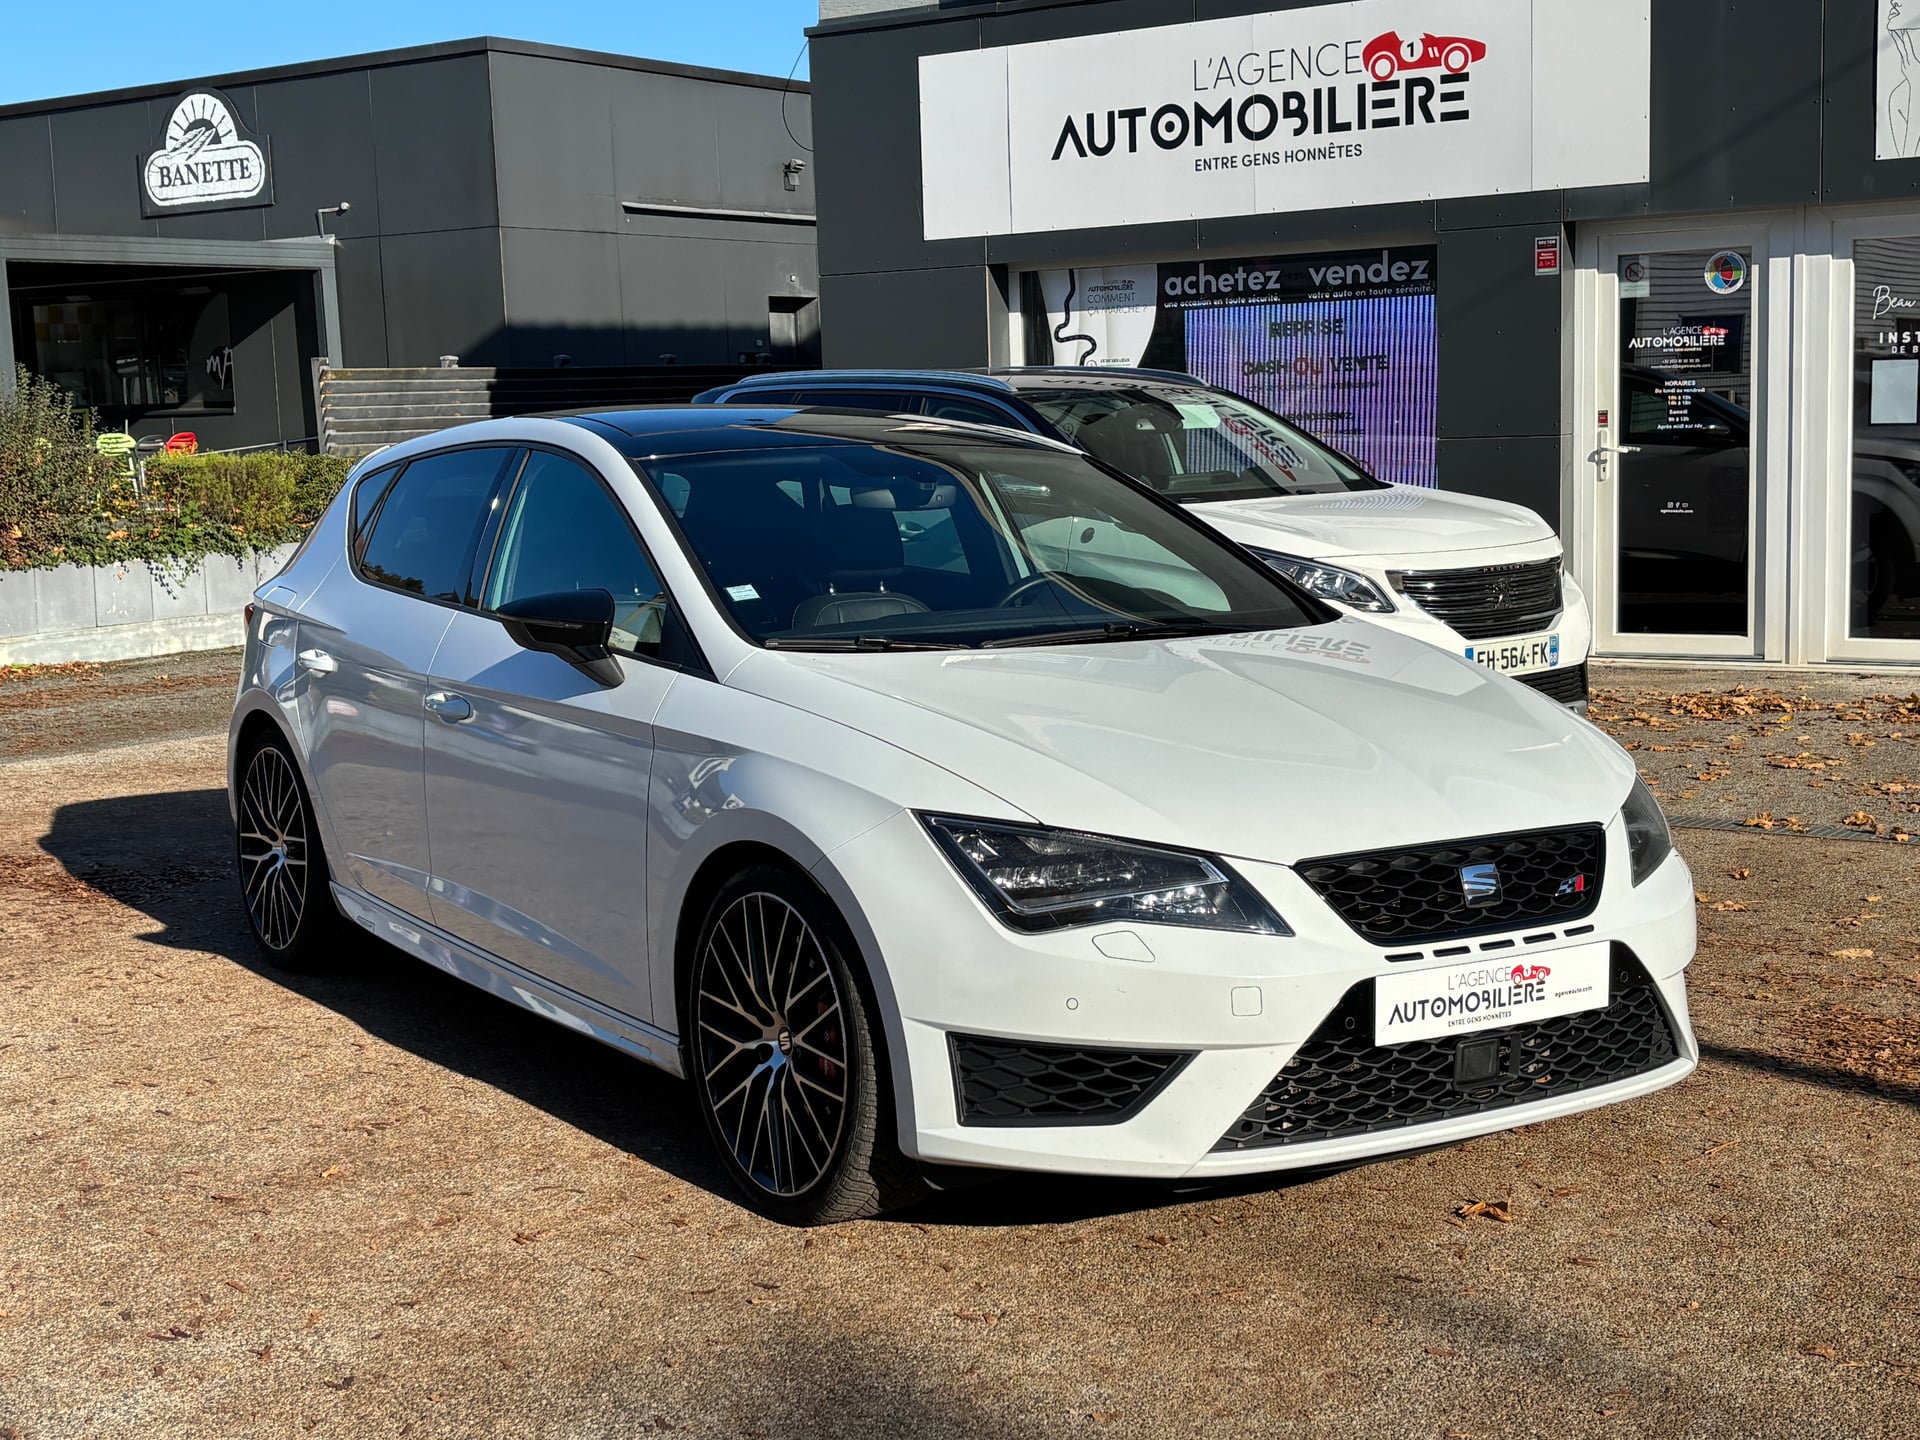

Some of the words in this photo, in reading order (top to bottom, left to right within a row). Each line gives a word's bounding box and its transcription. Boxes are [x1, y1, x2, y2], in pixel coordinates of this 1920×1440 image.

[1194, 40, 1362, 91] L'AGENCE
[1194, 156, 1238, 172] ENTRE
[1242, 151, 1280, 167] GENS
[1284, 142, 1363, 163] HONNÊTES
[159, 157, 252, 188] BANETTE
[1308, 250, 1429, 286] vendez
[1164, 263, 1281, 296] achetez
[1087, 292, 1136, 304] COMMENT
[1332, 289, 1353, 298] auto
[1369, 287, 1393, 296] toute
[1269, 317, 1344, 337] REPRISE
[1663, 326, 1703, 335] L'AGENCE
[1891, 345, 1906, 354] DE
[1242, 358, 1288, 376] CASH
[1293, 356, 1324, 375] OU
[1329, 355, 1389, 371] VENTE
[1448, 966, 1511, 990] L'AGENCE
